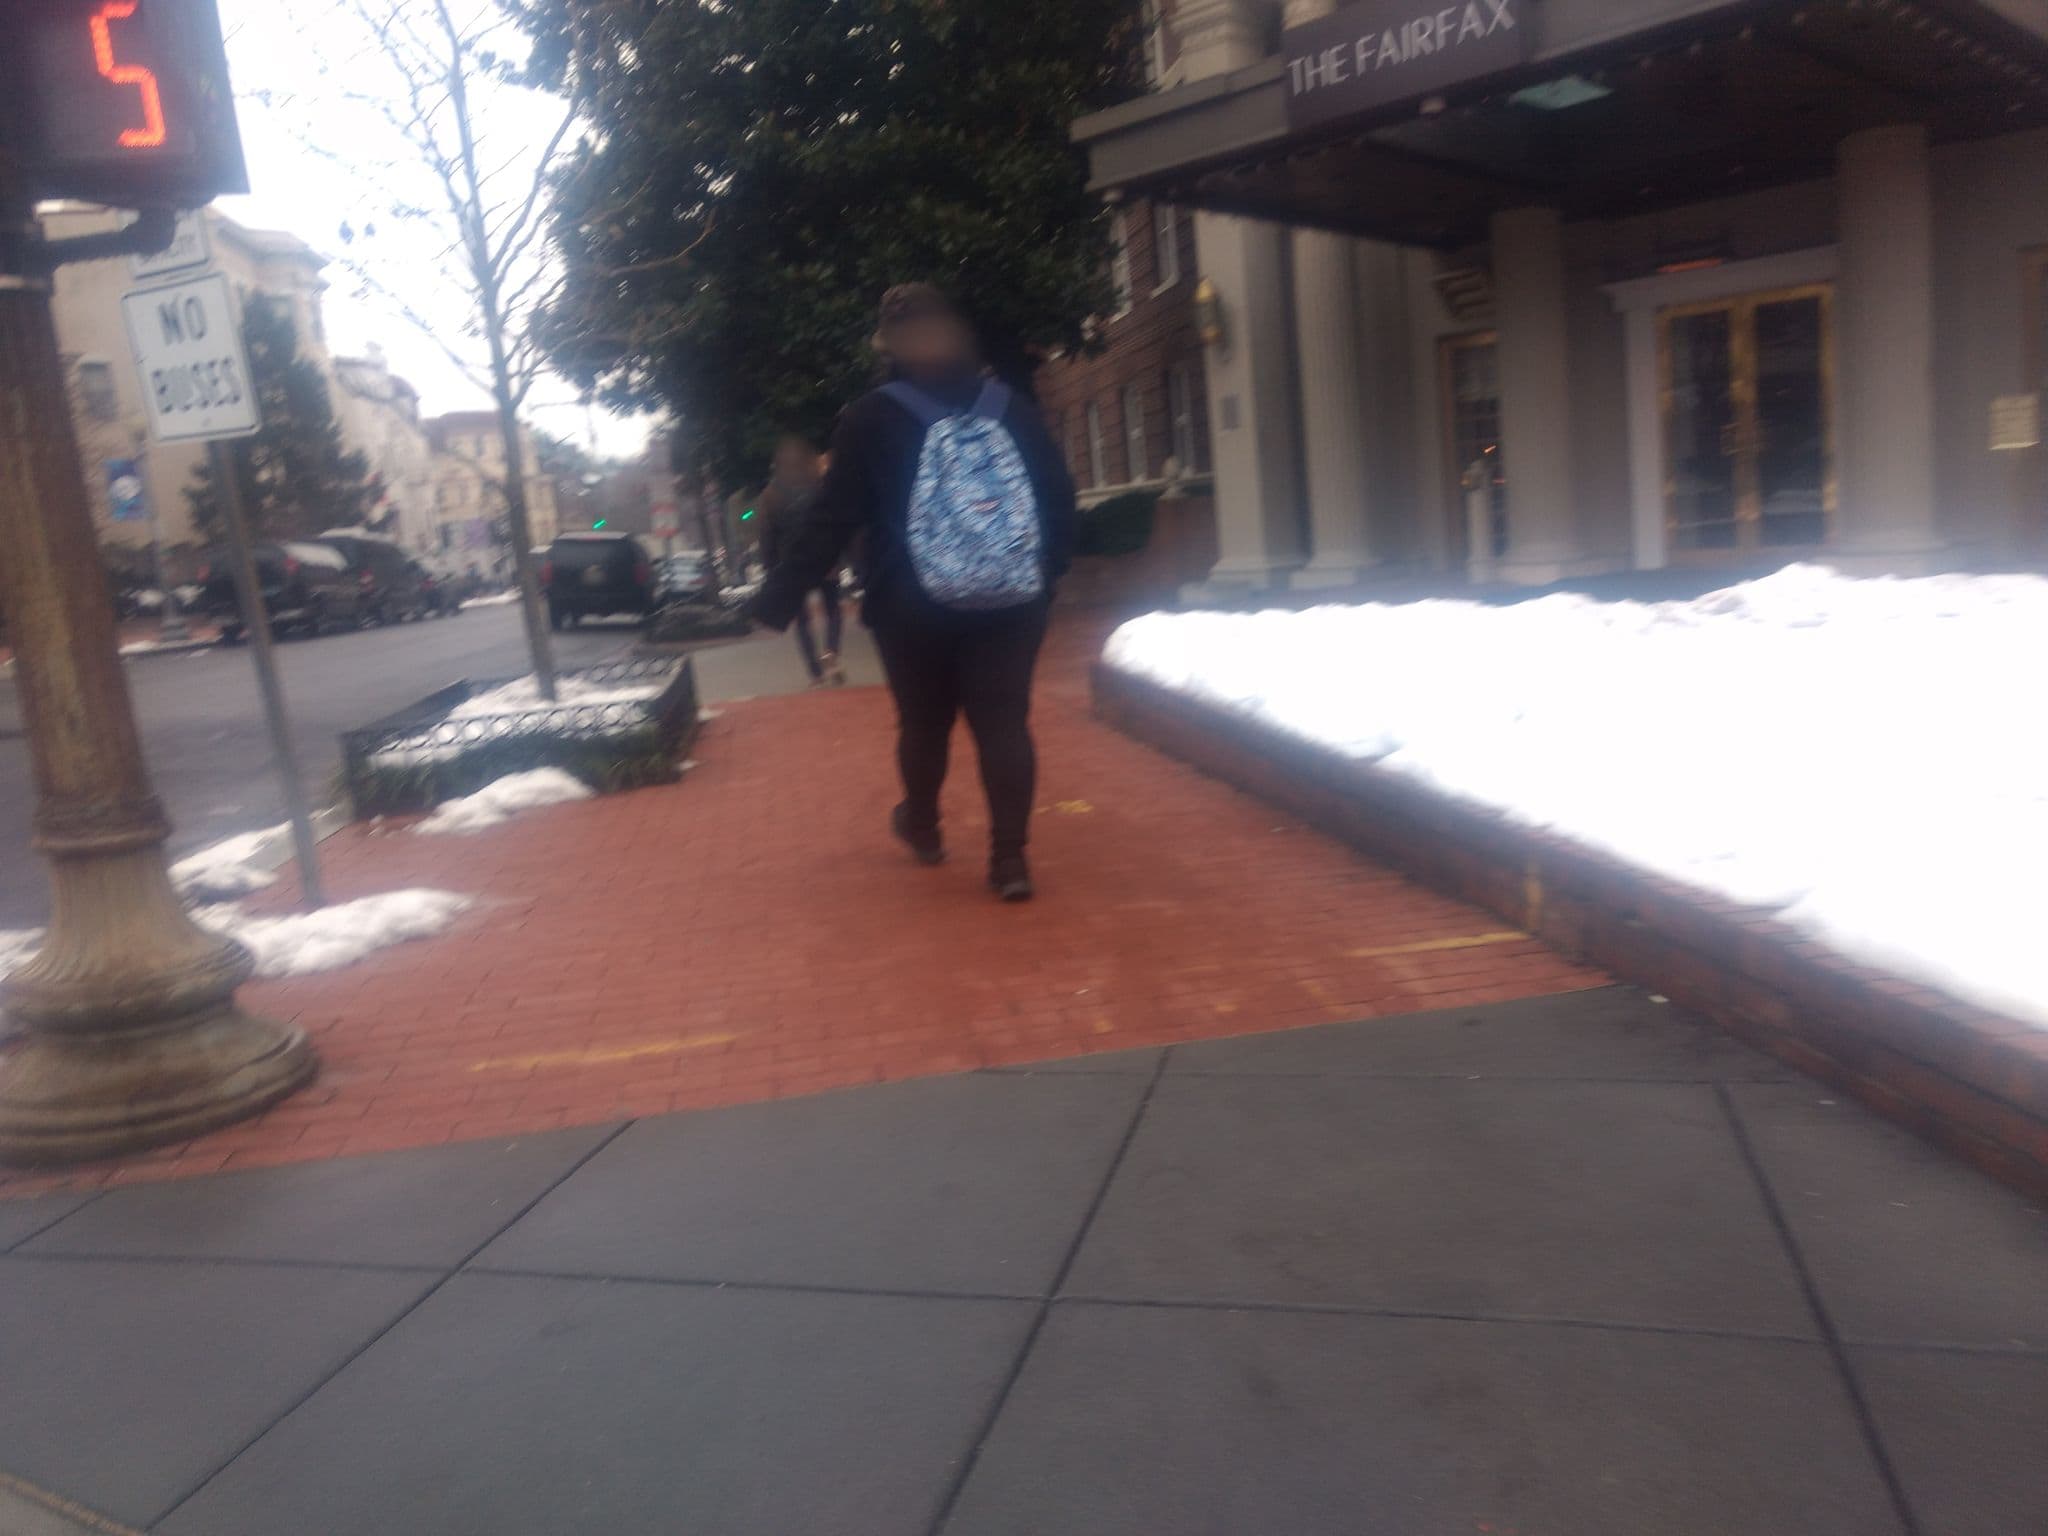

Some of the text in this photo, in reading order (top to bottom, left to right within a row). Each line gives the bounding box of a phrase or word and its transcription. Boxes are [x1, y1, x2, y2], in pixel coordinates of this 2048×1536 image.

[90, 0, 166, 148] 5
[1288, 0, 1515, 97] THE FAIRFAX
[158, 295, 208, 347] NO
